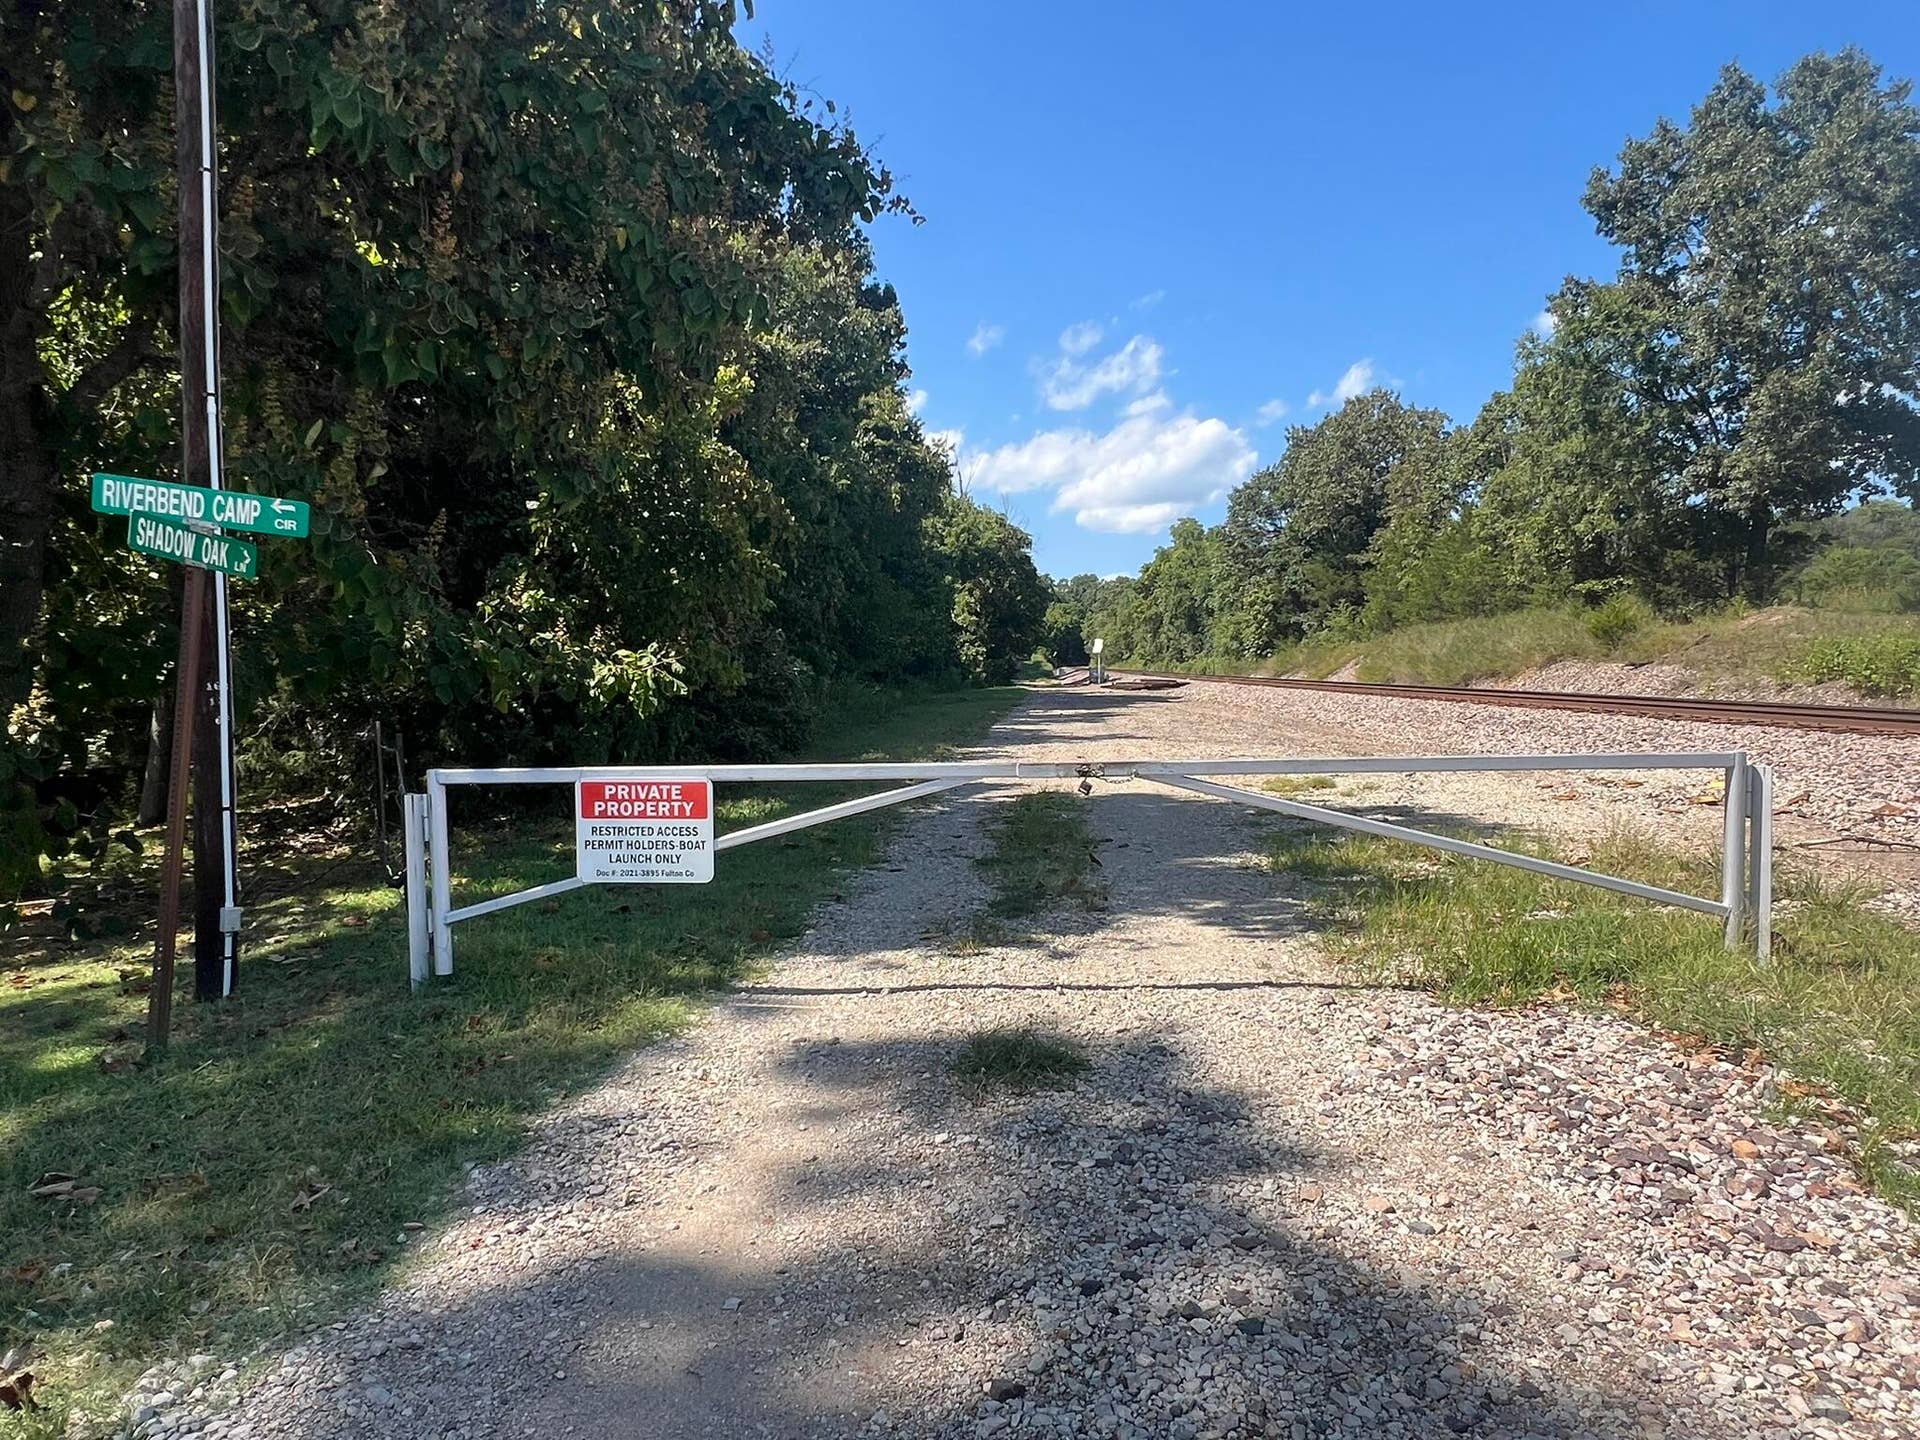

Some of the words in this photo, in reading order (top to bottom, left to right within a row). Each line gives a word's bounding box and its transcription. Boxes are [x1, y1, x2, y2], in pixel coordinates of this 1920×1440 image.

[102, 479, 205, 518] RIVERBEND
[212, 495, 261, 525] CAMP
[274, 518, 297, 531] CIR
[136, 517, 196, 559] SHADOW
[202, 537, 230, 569] OAK
[234, 561, 247, 573] LN
[604, 784, 683, 800] PRIVATE
[593, 801, 695, 817] PROPERTY
[591, 826, 655, 837] RESTRICTED
[656, 826, 699, 837] ACCESS
[584, 839, 626, 850] PERMIT
[626, 840, 707, 851] HOLDERS-BOAT
[609, 853, 652, 864] LAUNCH
[655, 853, 682, 864] ONLY
[596, 869, 609, 877] Doc
[661, 869, 684, 877] Fulton
[685, 869, 695, 877] Co
